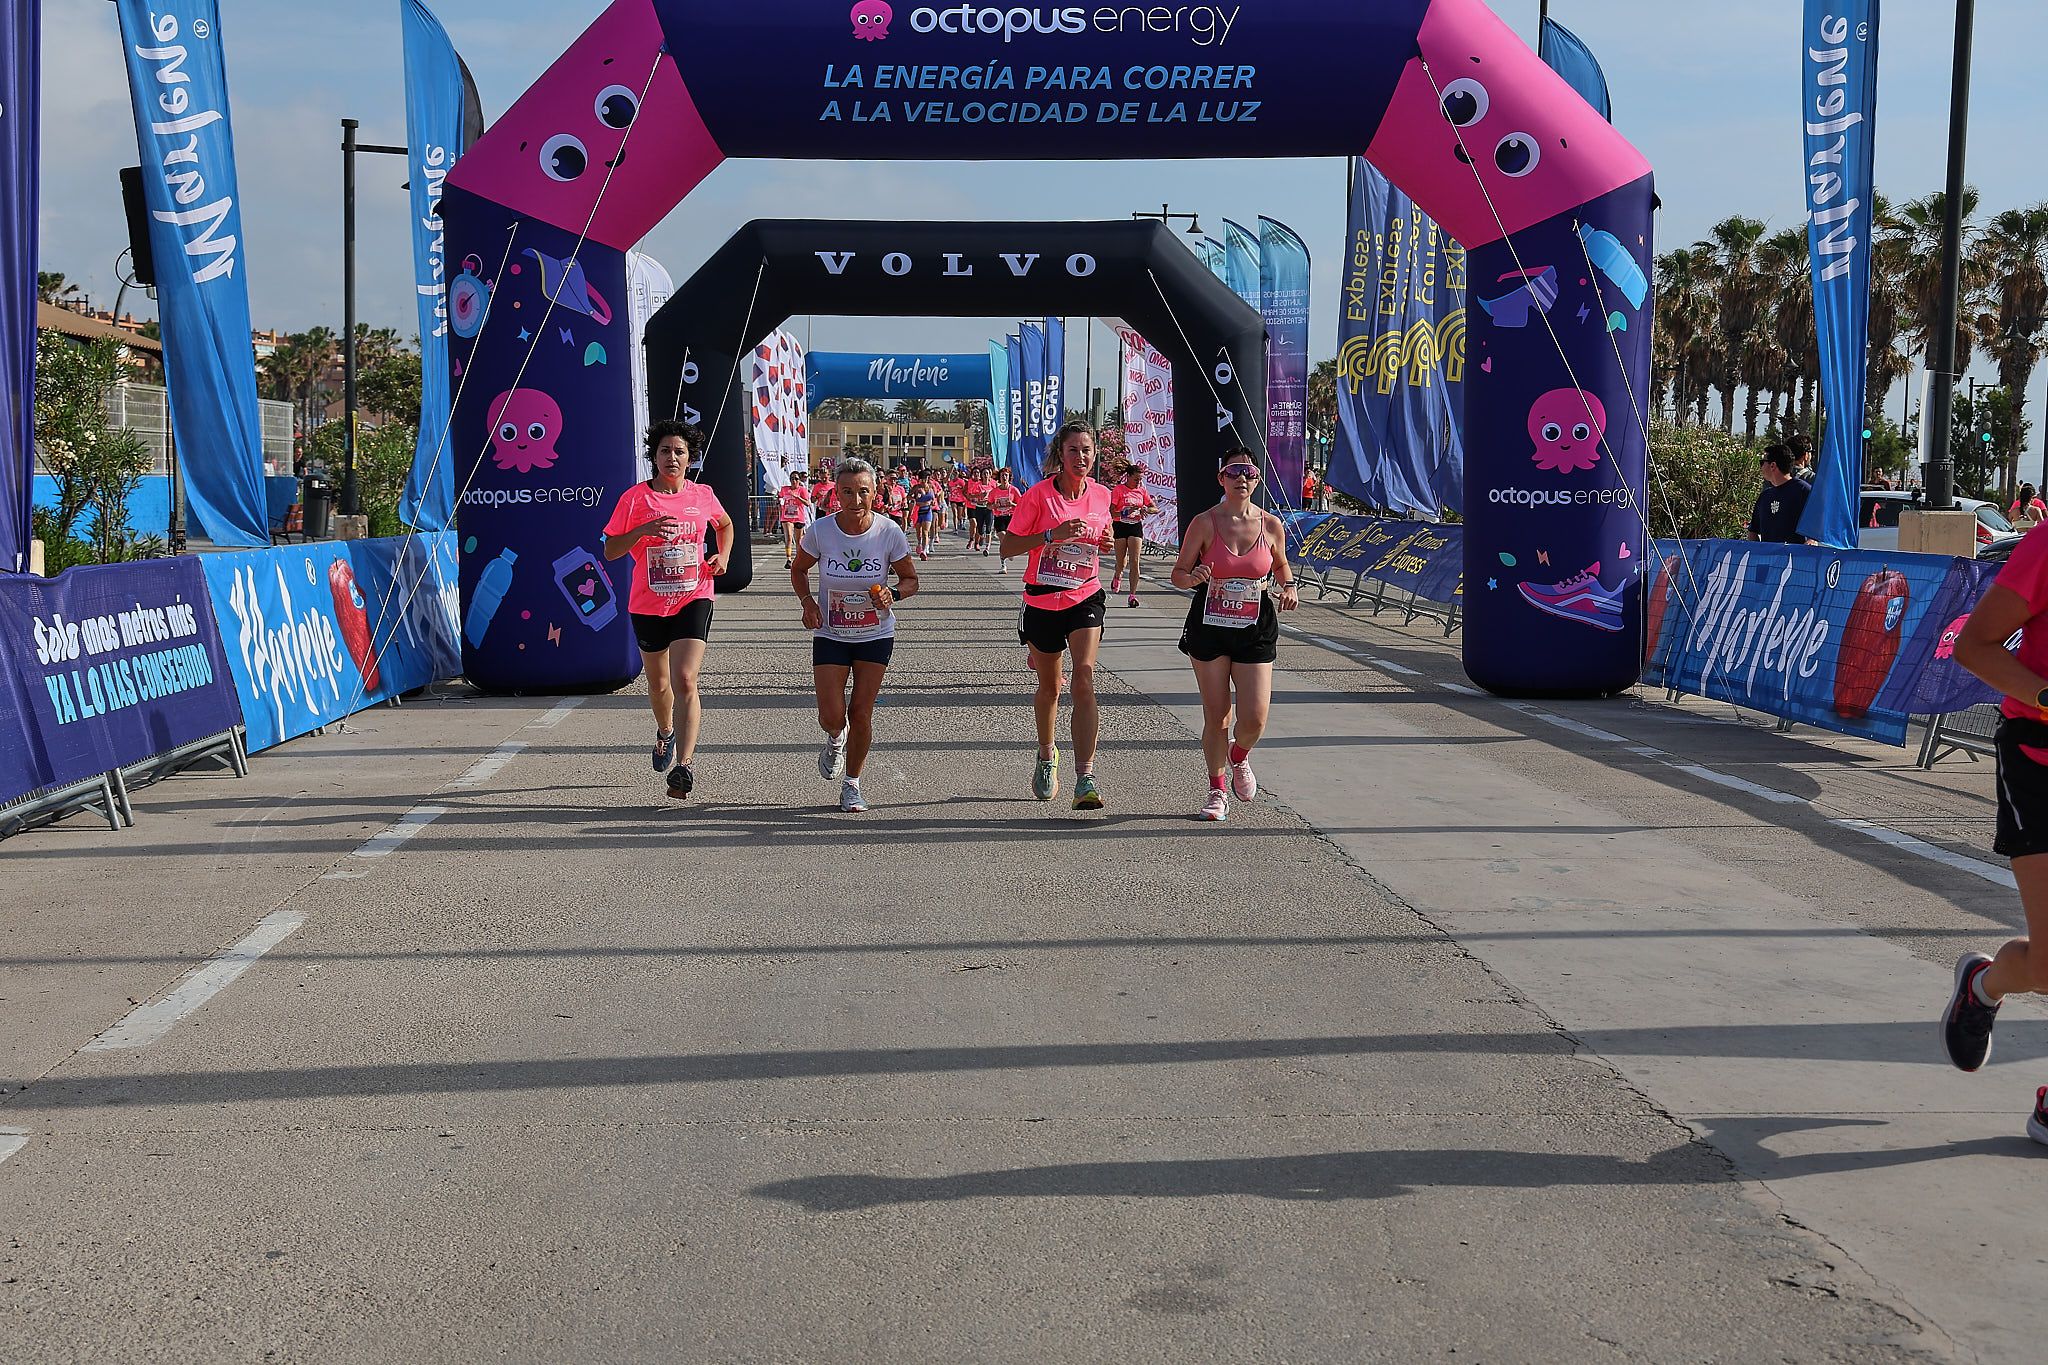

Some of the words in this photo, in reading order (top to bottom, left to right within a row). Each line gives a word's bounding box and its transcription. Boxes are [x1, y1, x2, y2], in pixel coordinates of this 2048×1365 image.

[910, 3, 1086, 42] octopus
[1093, 5, 1240, 45] energy
[824, 64, 863, 88] LA
[874, 60, 1014, 90] ENERGÍA
[1025, 66, 1112, 90] PARA
[1123, 65, 1255, 89] CORRER
[819, 101, 842, 121] A
[852, 101, 891, 122] LA
[903, 101, 1087, 123] VELOCIDAD
[1097, 101, 1139, 123] DE
[1147, 101, 1187, 123] LA
[1198, 101, 1261, 122] LUZ
[814, 251, 1097, 277] VOLVO
[868, 357, 948, 393] Marlene
[463, 486, 532, 508] octopus
[534, 485, 604, 507] energy
[1488, 486, 1572, 509] octopus
[1574, 487, 1636, 509] energy
[664, 566, 685, 576] 016
[1056, 559, 1077, 573] 016
[844, 611, 865, 620] 016
[1222, 599, 1243, 610] 016
[33, 614, 80, 666] Solo
[81, 613, 120, 656] unos
[118, 601, 171, 647] metros
[169, 594, 197, 640] más
[1686, 550, 1830, 700] Marlene
[229, 560, 344, 741] Marlene
[44, 674, 78, 726] YA
[71, 664, 104, 720] LO
[100, 657, 134, 709] HAS
[131, 642, 214, 700] CONSEGUIDO
